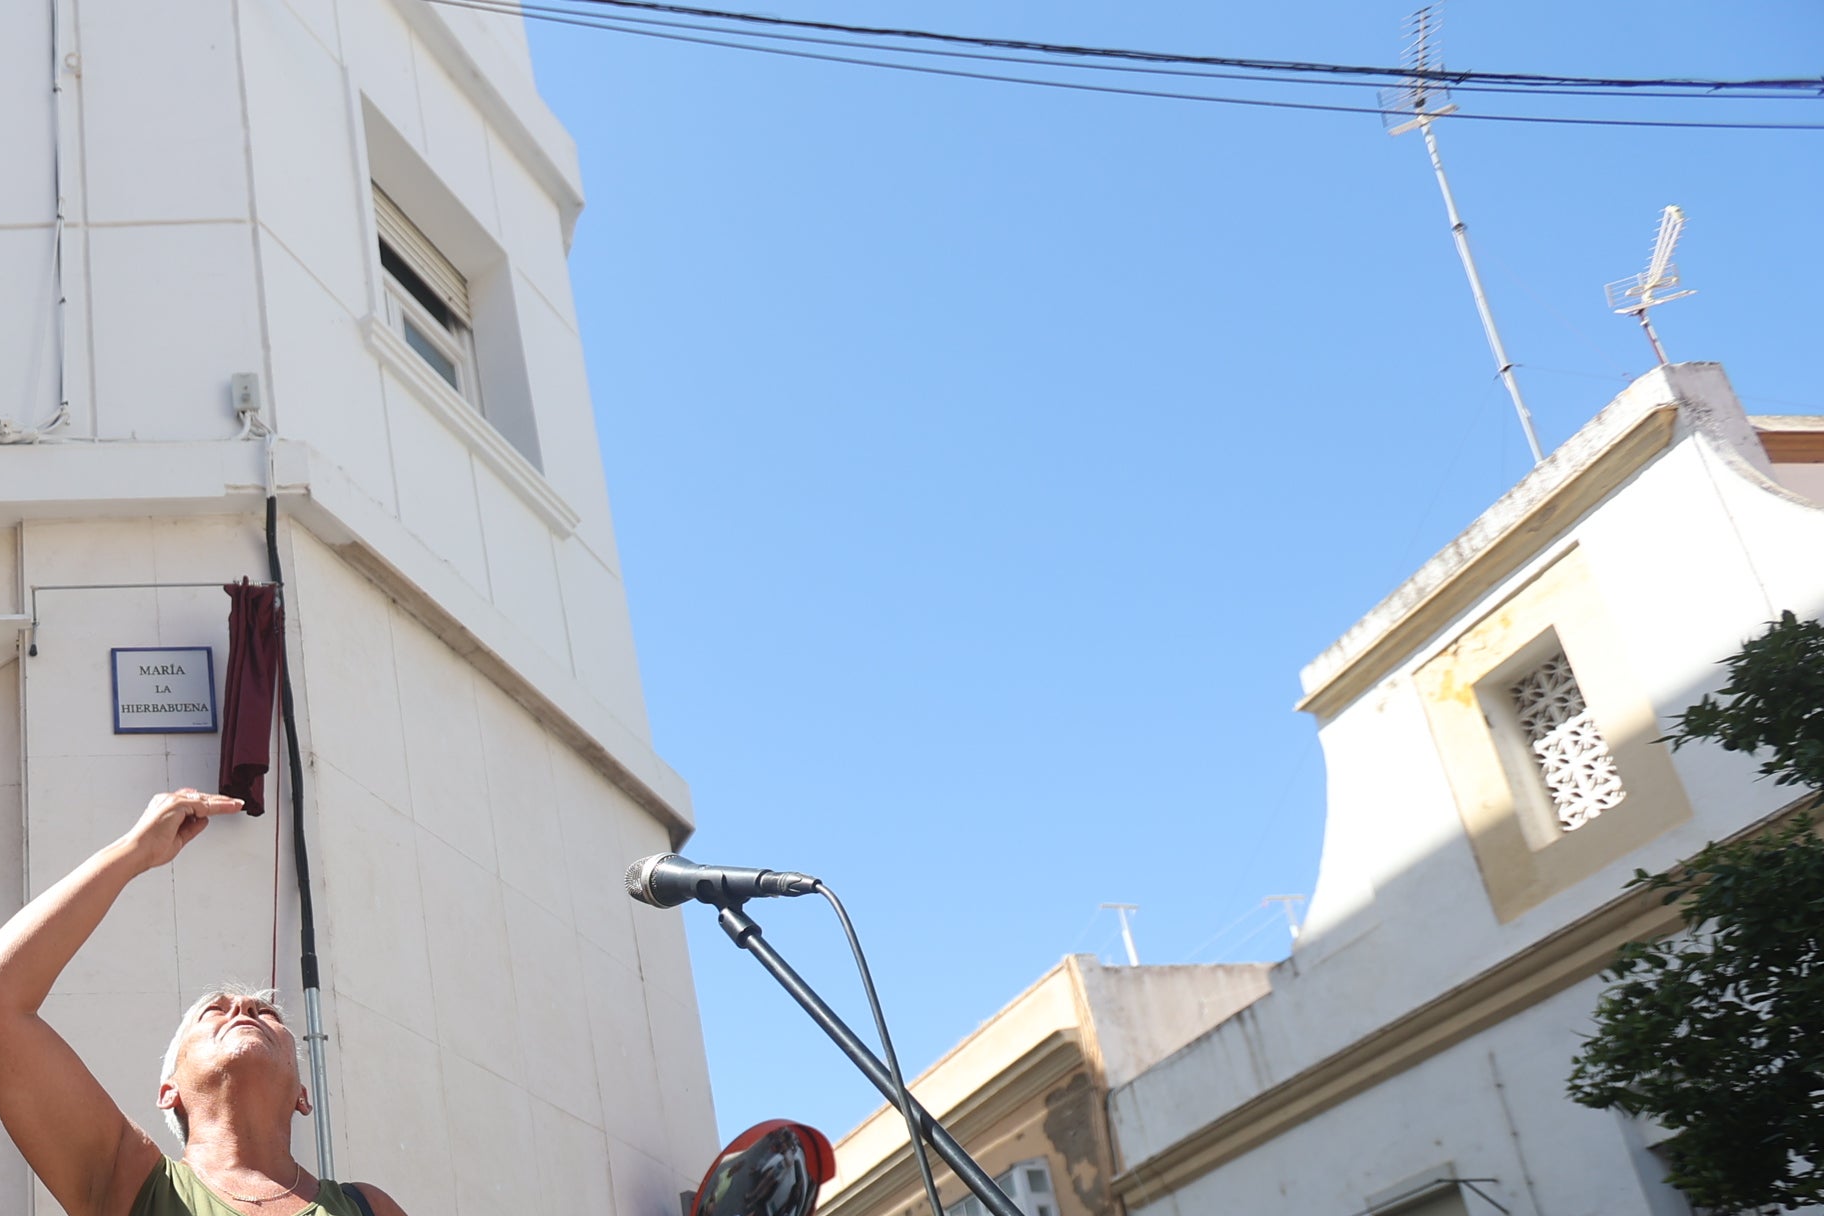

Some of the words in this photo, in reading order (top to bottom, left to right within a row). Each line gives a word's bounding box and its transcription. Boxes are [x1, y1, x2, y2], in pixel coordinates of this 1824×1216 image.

[139, 663, 186, 676] MARÍA
[155, 685, 172, 694] LA
[121, 703, 209, 714] HIERBABUENA
